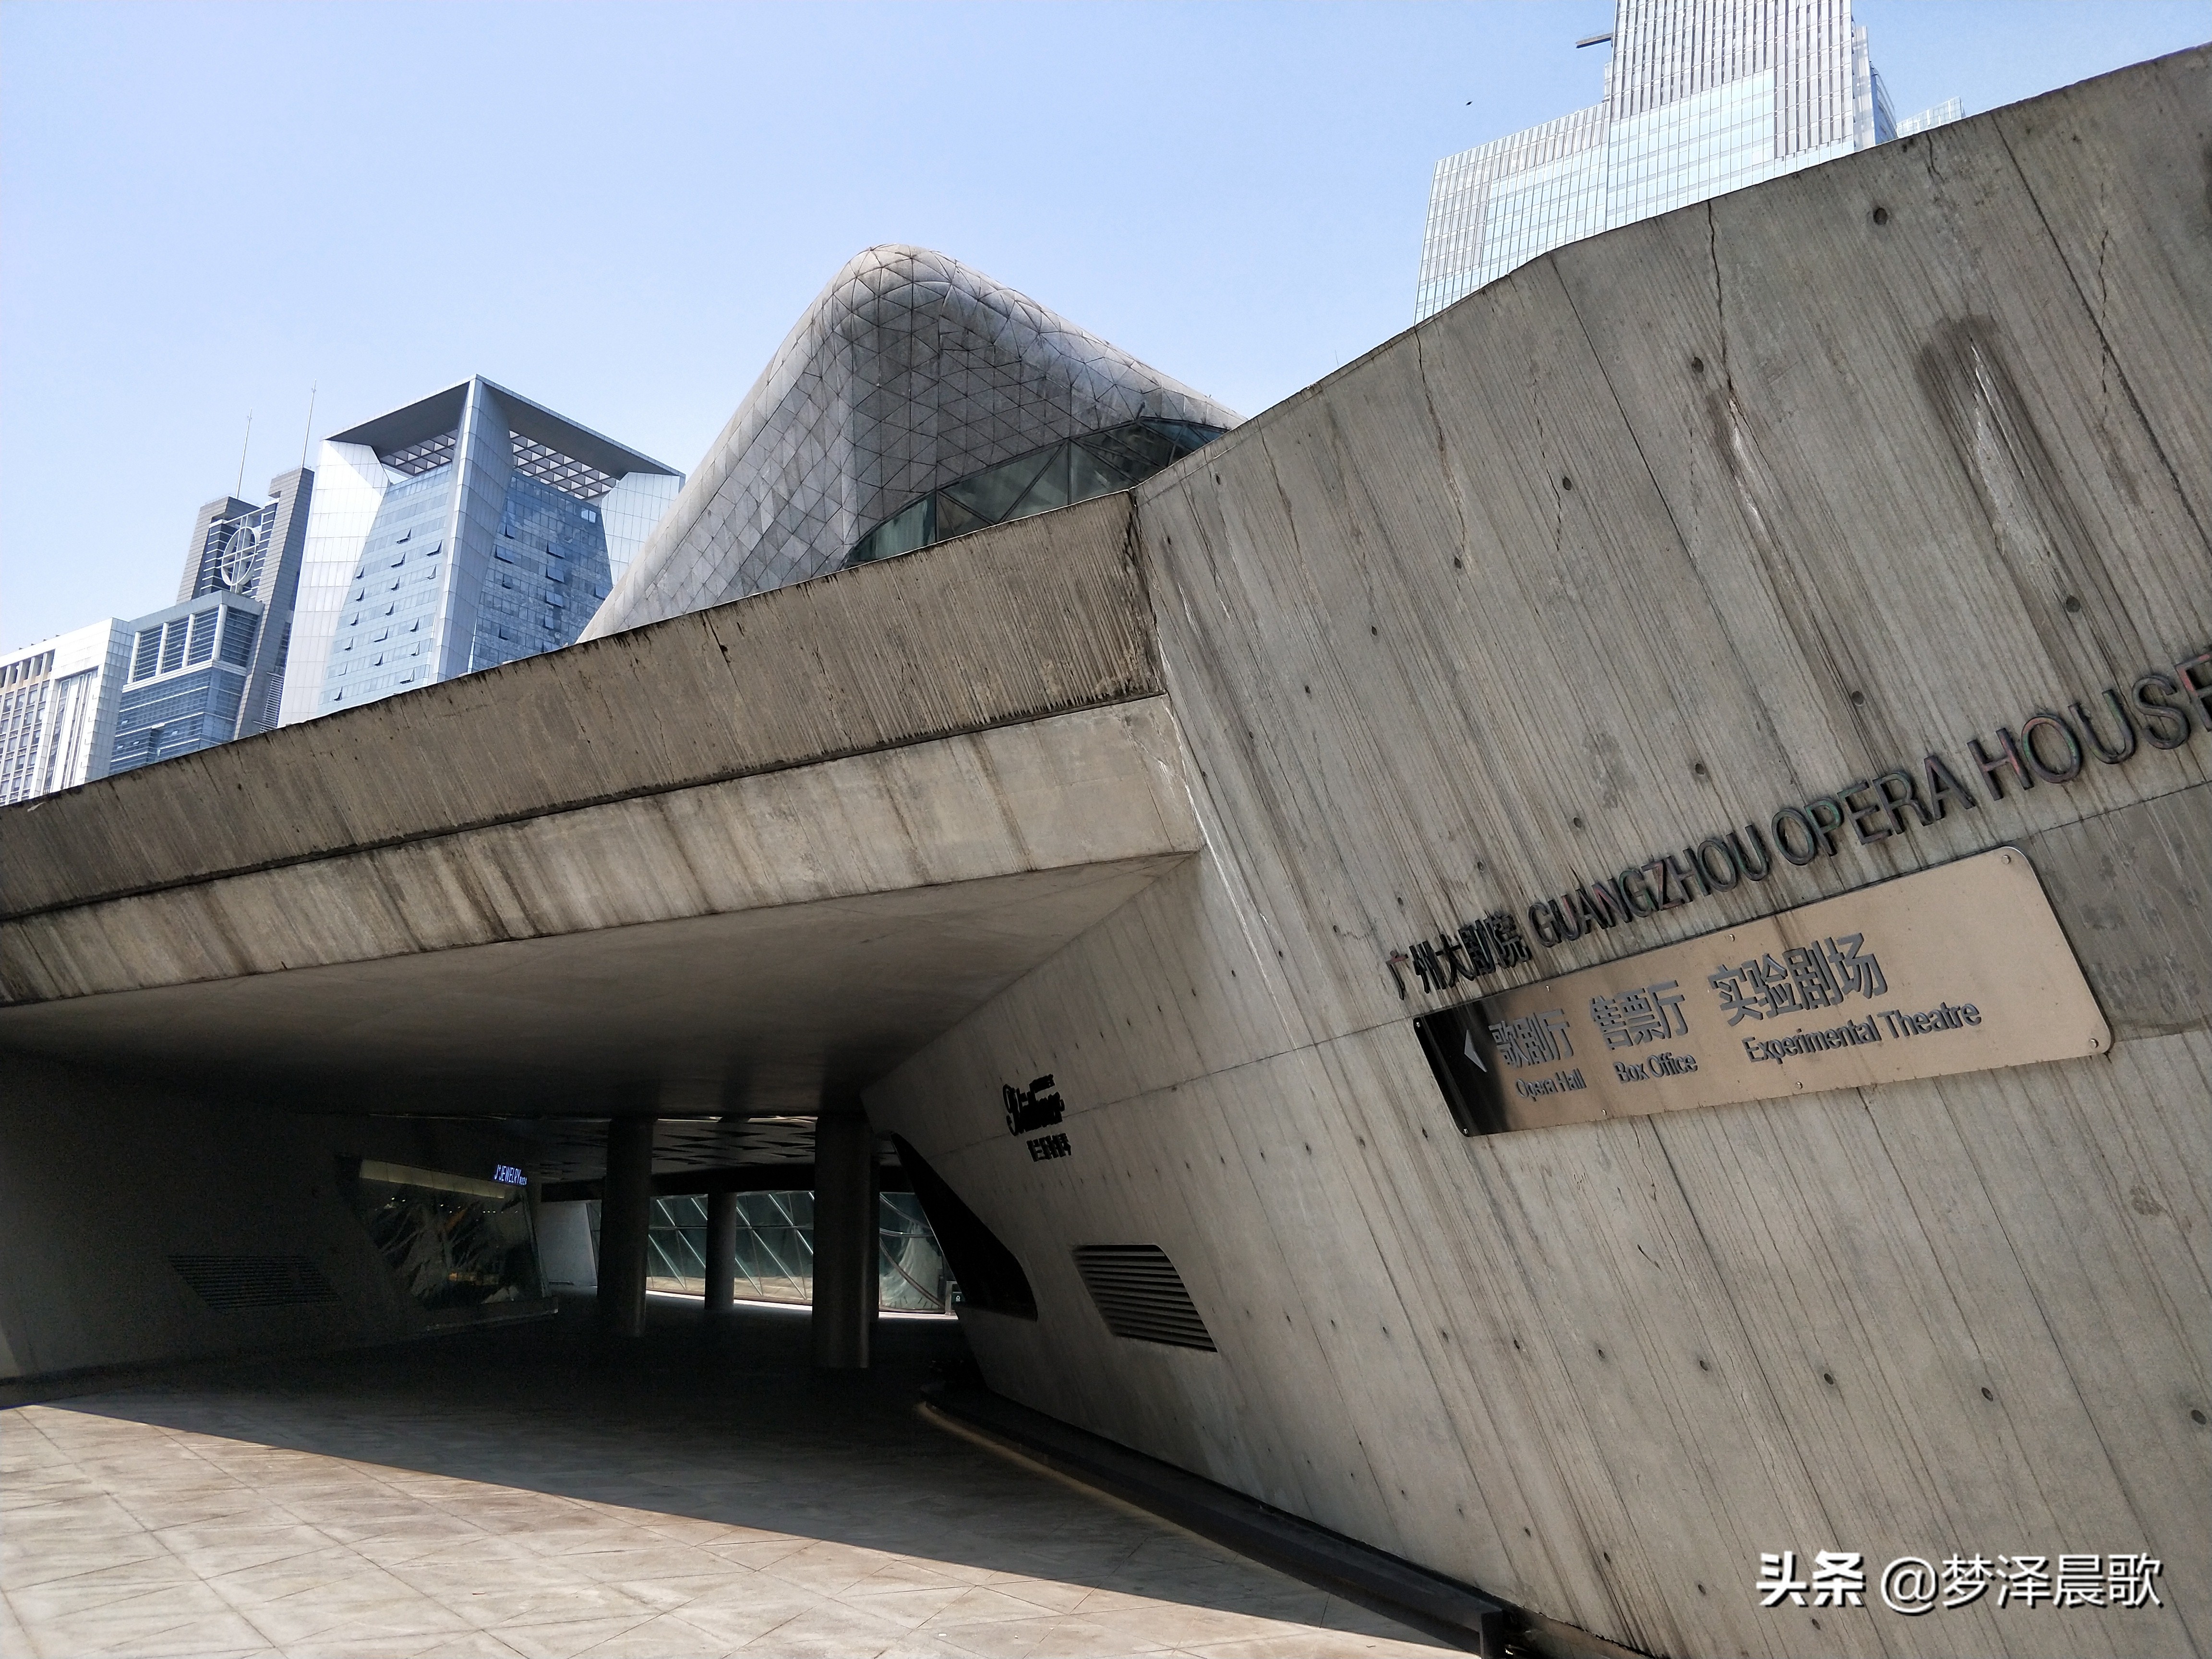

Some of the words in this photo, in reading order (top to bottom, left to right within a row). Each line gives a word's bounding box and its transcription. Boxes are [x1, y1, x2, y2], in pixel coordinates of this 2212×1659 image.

[1386, 911, 1532, 1000] 广州大剧院
[1528, 825, 1771, 948] GUANGZHOU
[1770, 755, 1976, 865] OPERA
[1488, 1008, 1574, 1068] 歌剧厅
[1590, 980, 1688, 1050] 售票厅
[1707, 933, 1888, 1026] 实验剧场
[1742, 1015, 1883, 1064] Experimental
[1877, 1001, 1983, 1039] Theatre
[1515, 1078, 1559, 1102] Opera
[1556, 1068, 1587, 1092] Hall
[1613, 1061, 1650, 1084] Box
[1647, 1052, 1698, 1078] Office
